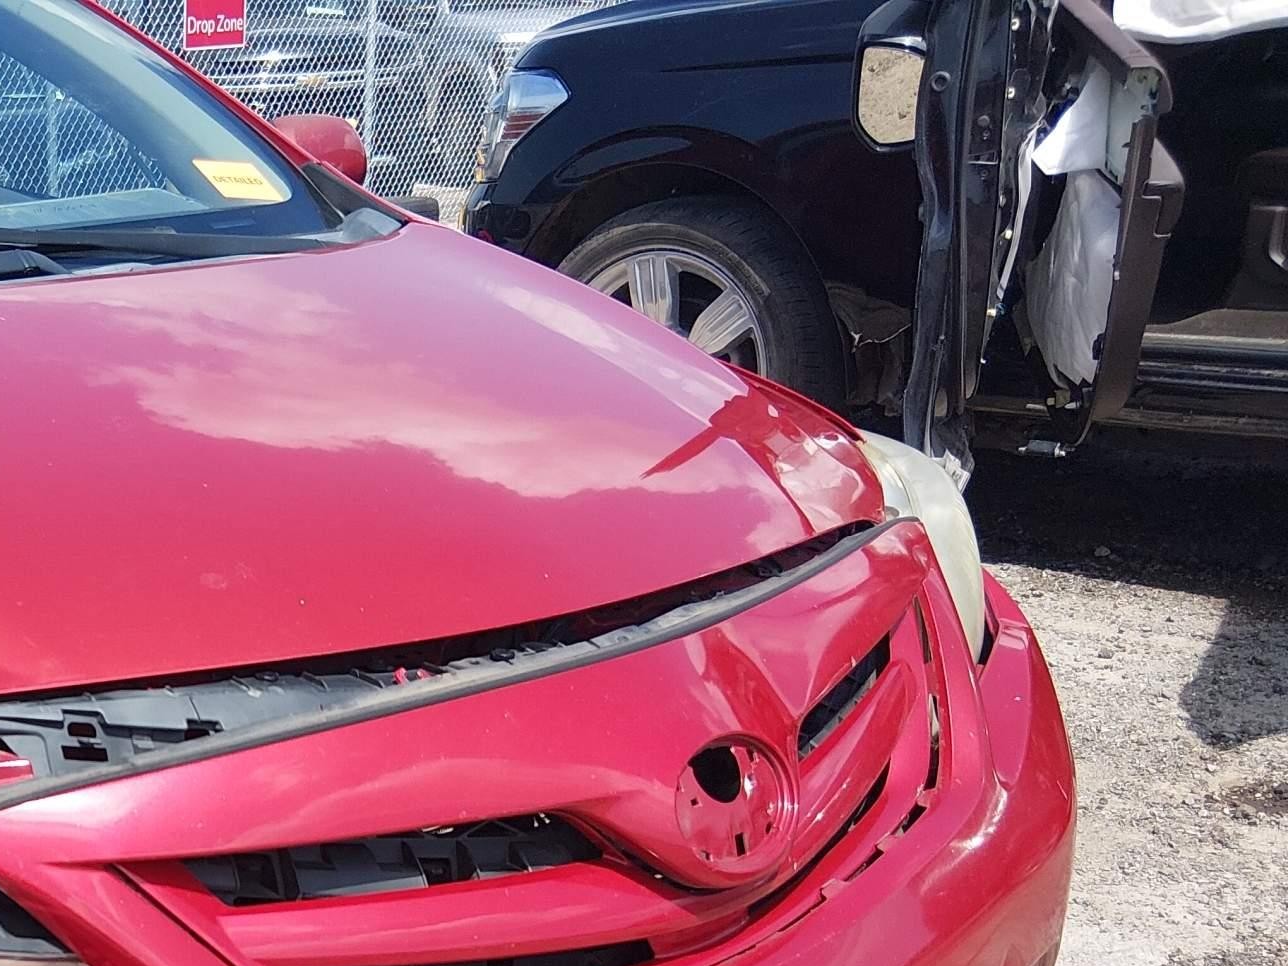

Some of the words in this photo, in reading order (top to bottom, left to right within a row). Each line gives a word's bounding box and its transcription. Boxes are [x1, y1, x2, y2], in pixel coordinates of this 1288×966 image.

[187, 16, 215, 36] Drop
[216, 14, 243, 32] Zone
[211, 175, 264, 186] DETAILED
